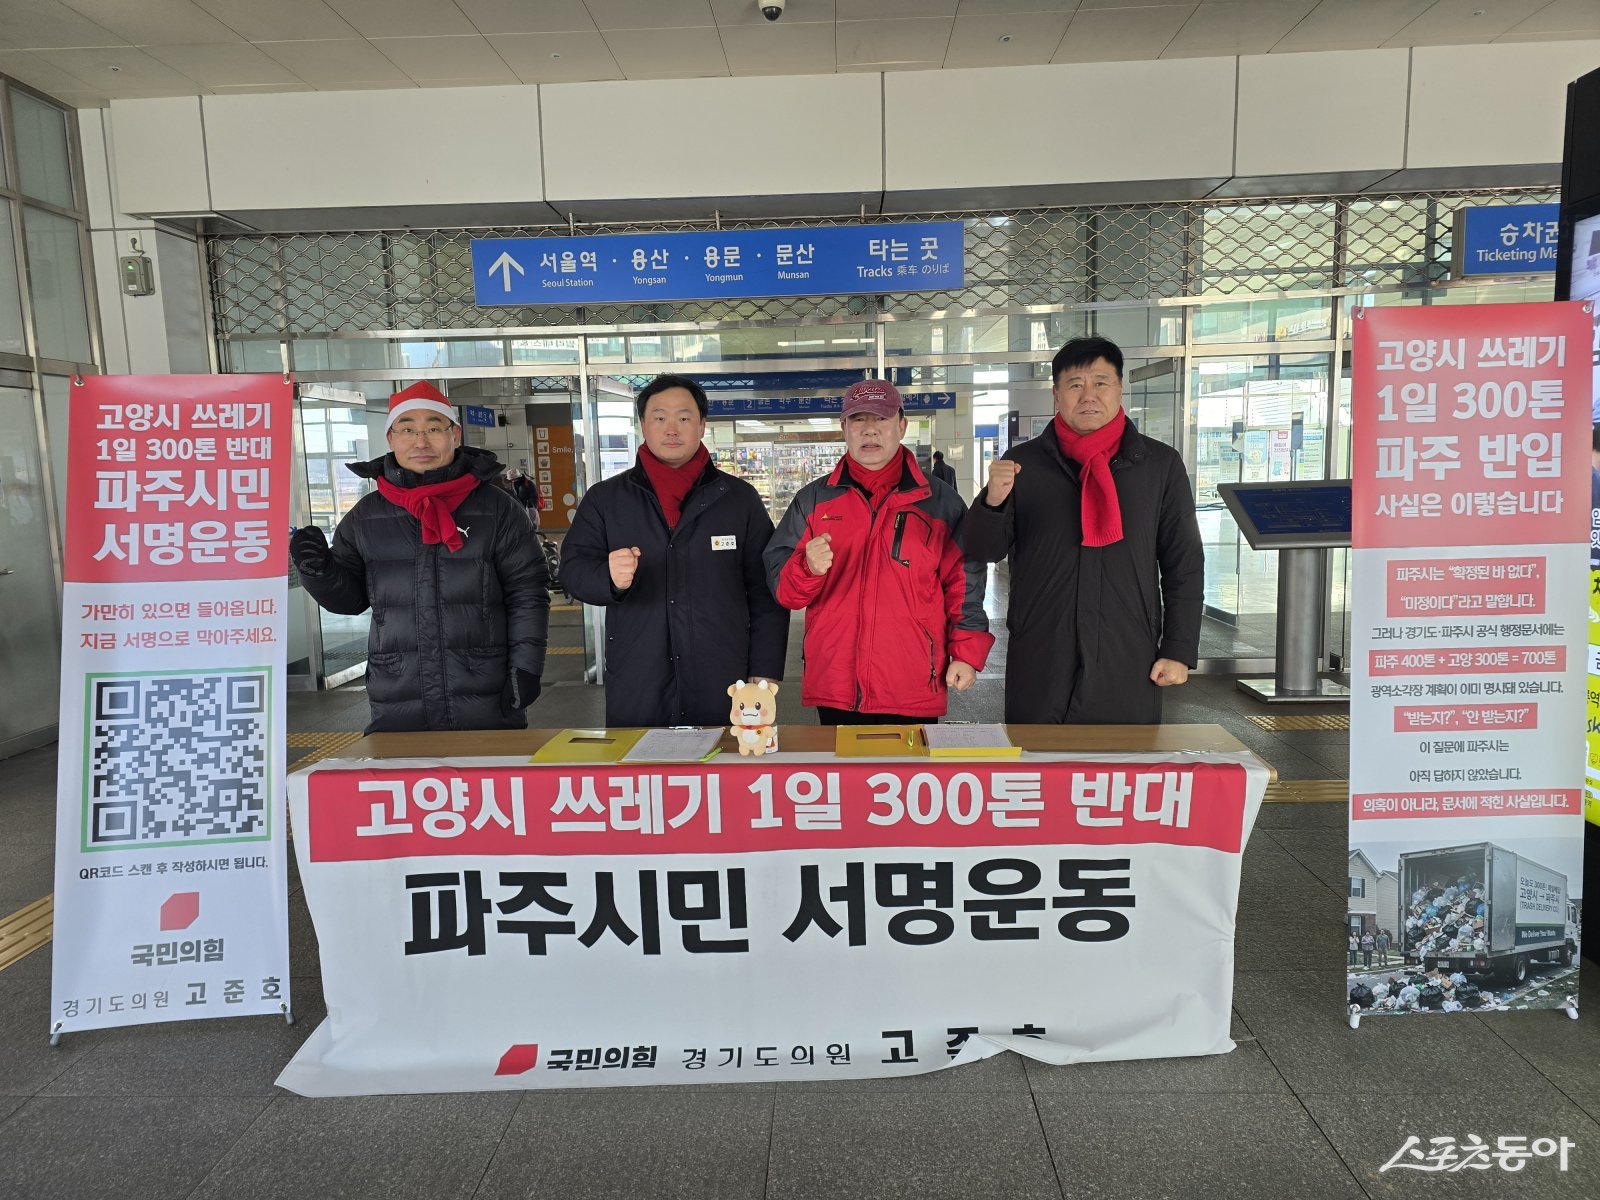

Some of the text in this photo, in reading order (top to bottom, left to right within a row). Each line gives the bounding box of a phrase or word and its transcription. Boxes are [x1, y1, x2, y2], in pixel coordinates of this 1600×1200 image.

[1500, 221, 1559, 246] 승차권
[540, 236, 939, 274] 서울역 용산 용문 문산 타는 곳
[1476, 248, 1536, 263] Ticketing
[542, 278, 565, 288] Seoul
[565, 278, 594, 288] Station
[632, 276, 666, 286] Yongsan
[705, 273, 743, 284] Yongmun
[777, 271, 810, 280] Munsan
[857, 265, 893, 279] Tracks
[921, 263, 950, 275] のりば
[1376, 338, 1466, 372] 고양시
[1477, 335, 1566, 369] 쓰레기
[1377, 379, 1565, 424] 1일 300톤
[96, 402, 272, 431] 고양시 쓰레기
[96, 436, 272, 462] 1일 300톤 반대
[1375, 435, 1461, 482] 파주
[1479, 432, 1562, 479] 반입
[94, 467, 270, 513] 파주시민
[1376, 490, 1564, 518] 사실은 이렇습니다
[93, 520, 270, 565] 서명운동
[1396, 567, 1445, 582] 파주시는
[1492, 565, 1505, 579] 바
[82, 599, 277, 621] 가만히 있으면 들어옵니다.
[1485, 593, 1536, 609] 말합니다.
[80, 628, 277, 650] 지금 서명으로 막아주세요.
[1371, 627, 1403, 640] 그러나
[1476, 624, 1498, 638] 공식
[1500, 623, 1565, 637] 행정문서에는
[1374, 655, 1399, 669] 파주
[1401, 654, 1436, 669] 400톤
[1448, 652, 1473, 668] 고양
[1475, 652, 1509, 667] 300톤
[1521, 651, 1557, 665] 700톤
[1371, 680, 1564, 699] 광역소각장 계획이 이미 명시돼 있습니다.
[1419, 739, 1510, 754] 이 질문에 파주시는
[1409, 767, 1522, 783] 아직 답하지 않았습니다.
[356, 771, 1193, 839] 고양시 쓰레기 1일 300톤 반대
[1363, 794, 1569, 813] 의혹이 아니라, 문서에 적힌 사실입니다.
[79, 856, 269, 880] QR코드 스캔 후 작성하시면 됩니다.
[404, 858, 1136, 956] 파주시민 서명운동
[131, 938, 224, 967] 국민의힘
[62, 990, 169, 1018] 경기도의원
[547, 1045, 658, 1071] 국민의힘
[682, 1043, 851, 1070] 경기도의원
